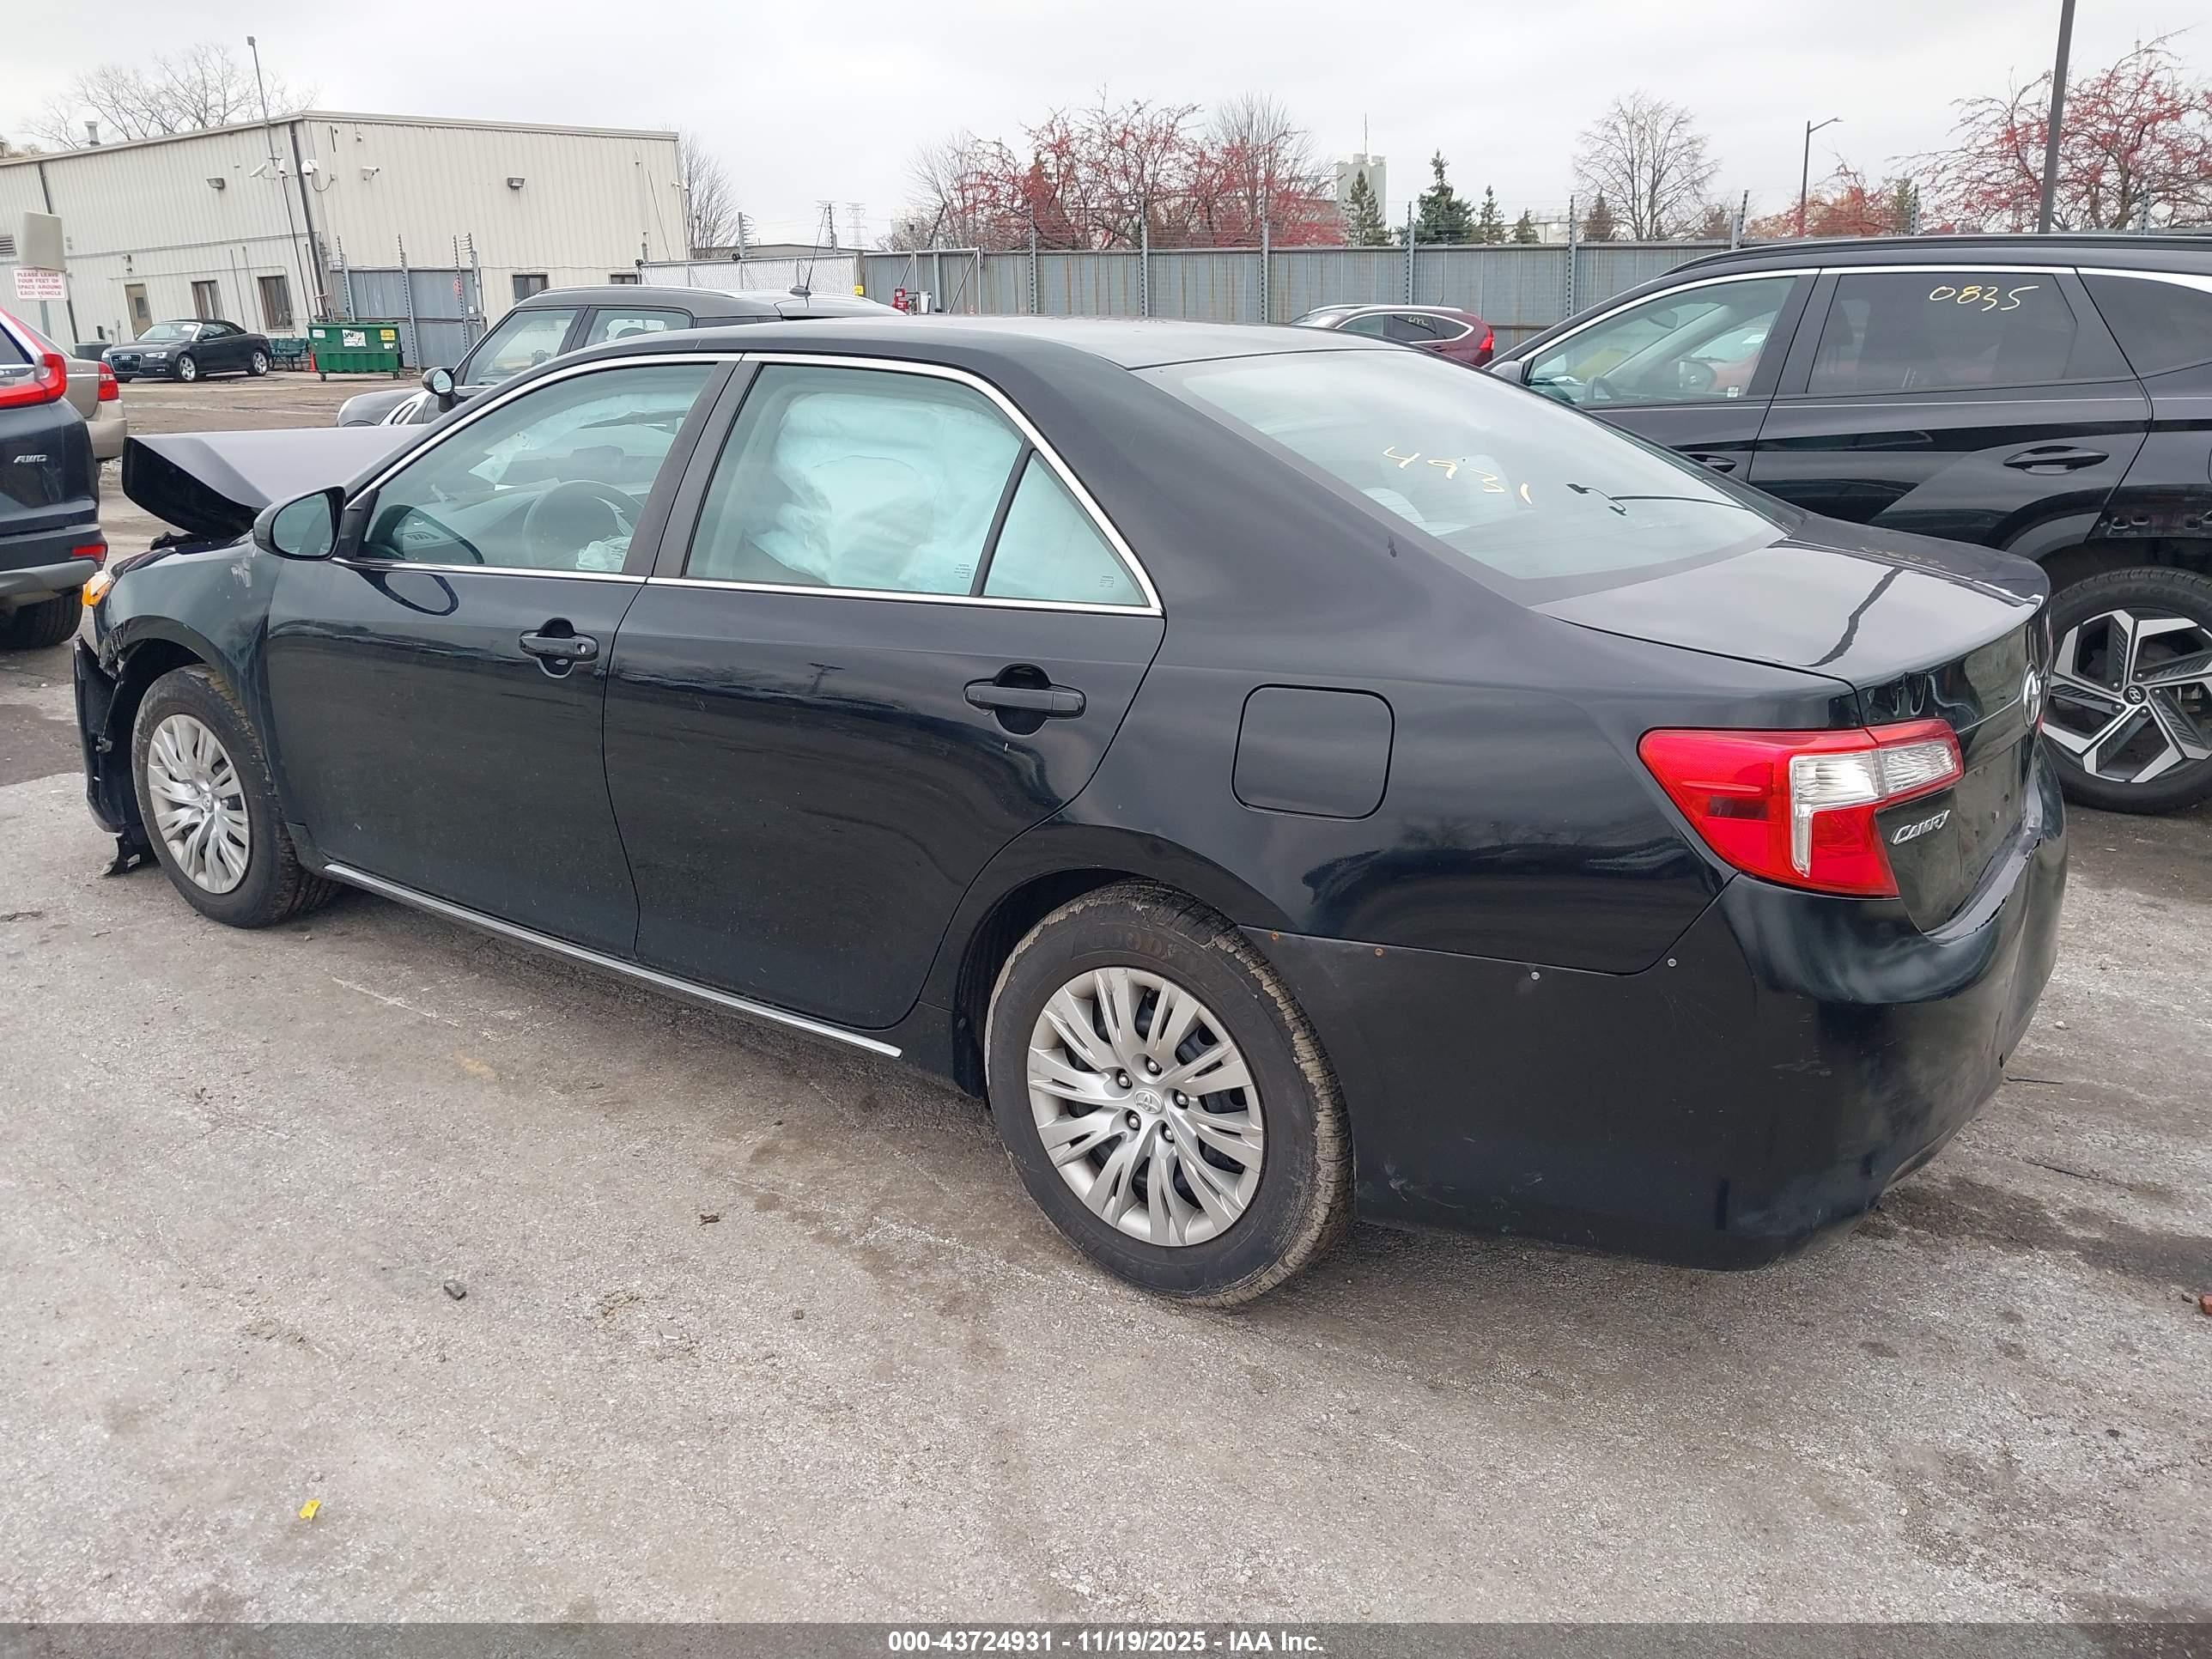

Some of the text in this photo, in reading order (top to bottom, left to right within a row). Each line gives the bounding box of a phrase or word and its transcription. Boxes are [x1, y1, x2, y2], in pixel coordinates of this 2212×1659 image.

[1929, 285, 2040, 312] 0835
[1381, 446, 1533, 505] 4931
[1891, 809, 1951, 846] CAMRY
